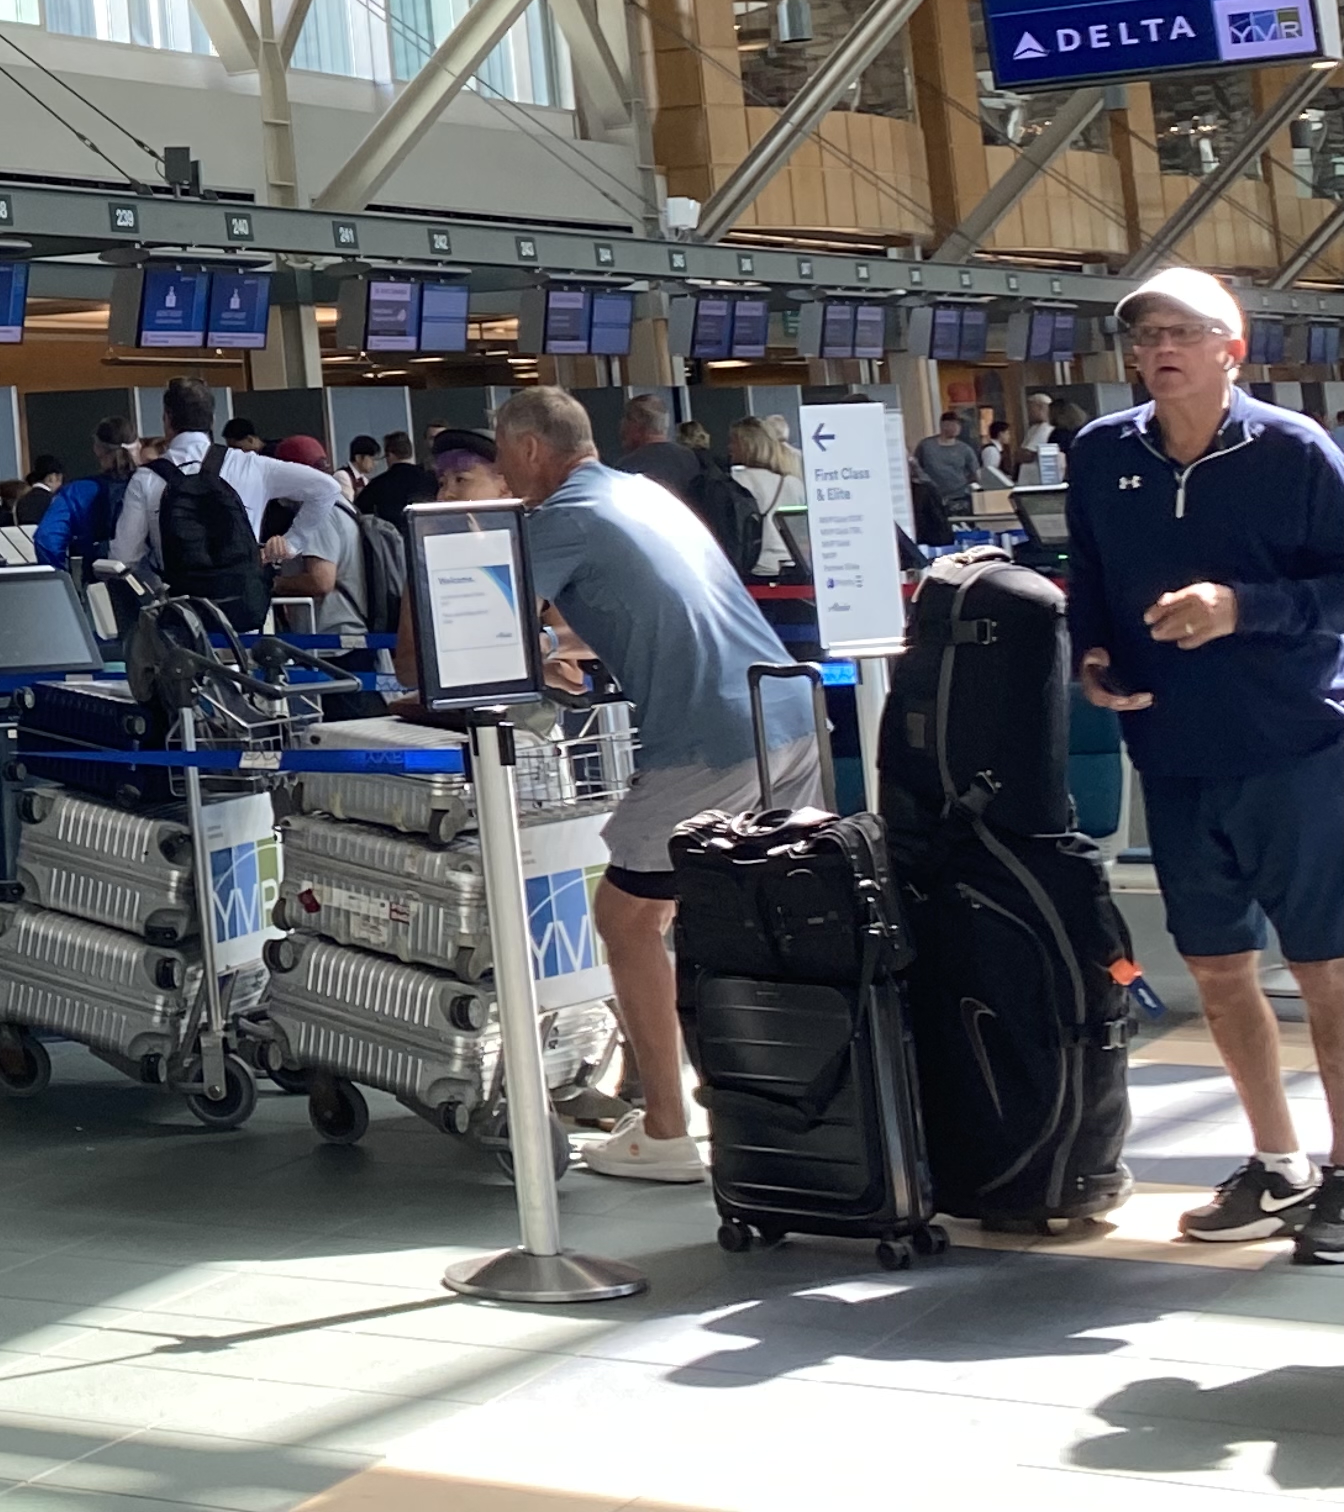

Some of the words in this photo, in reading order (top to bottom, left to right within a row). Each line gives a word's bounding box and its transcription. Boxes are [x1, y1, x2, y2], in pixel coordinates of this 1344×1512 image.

[1056, 15, 1196, 52] DELTA
[1230, 20, 1300, 45] YVR
[116, 209, 134, 227] 239
[232, 219, 248, 236] 240
[815, 468, 838, 481] First
[841, 468, 870, 480] Class
[816, 489, 825, 501] &
[827, 488, 851, 501] Elite
